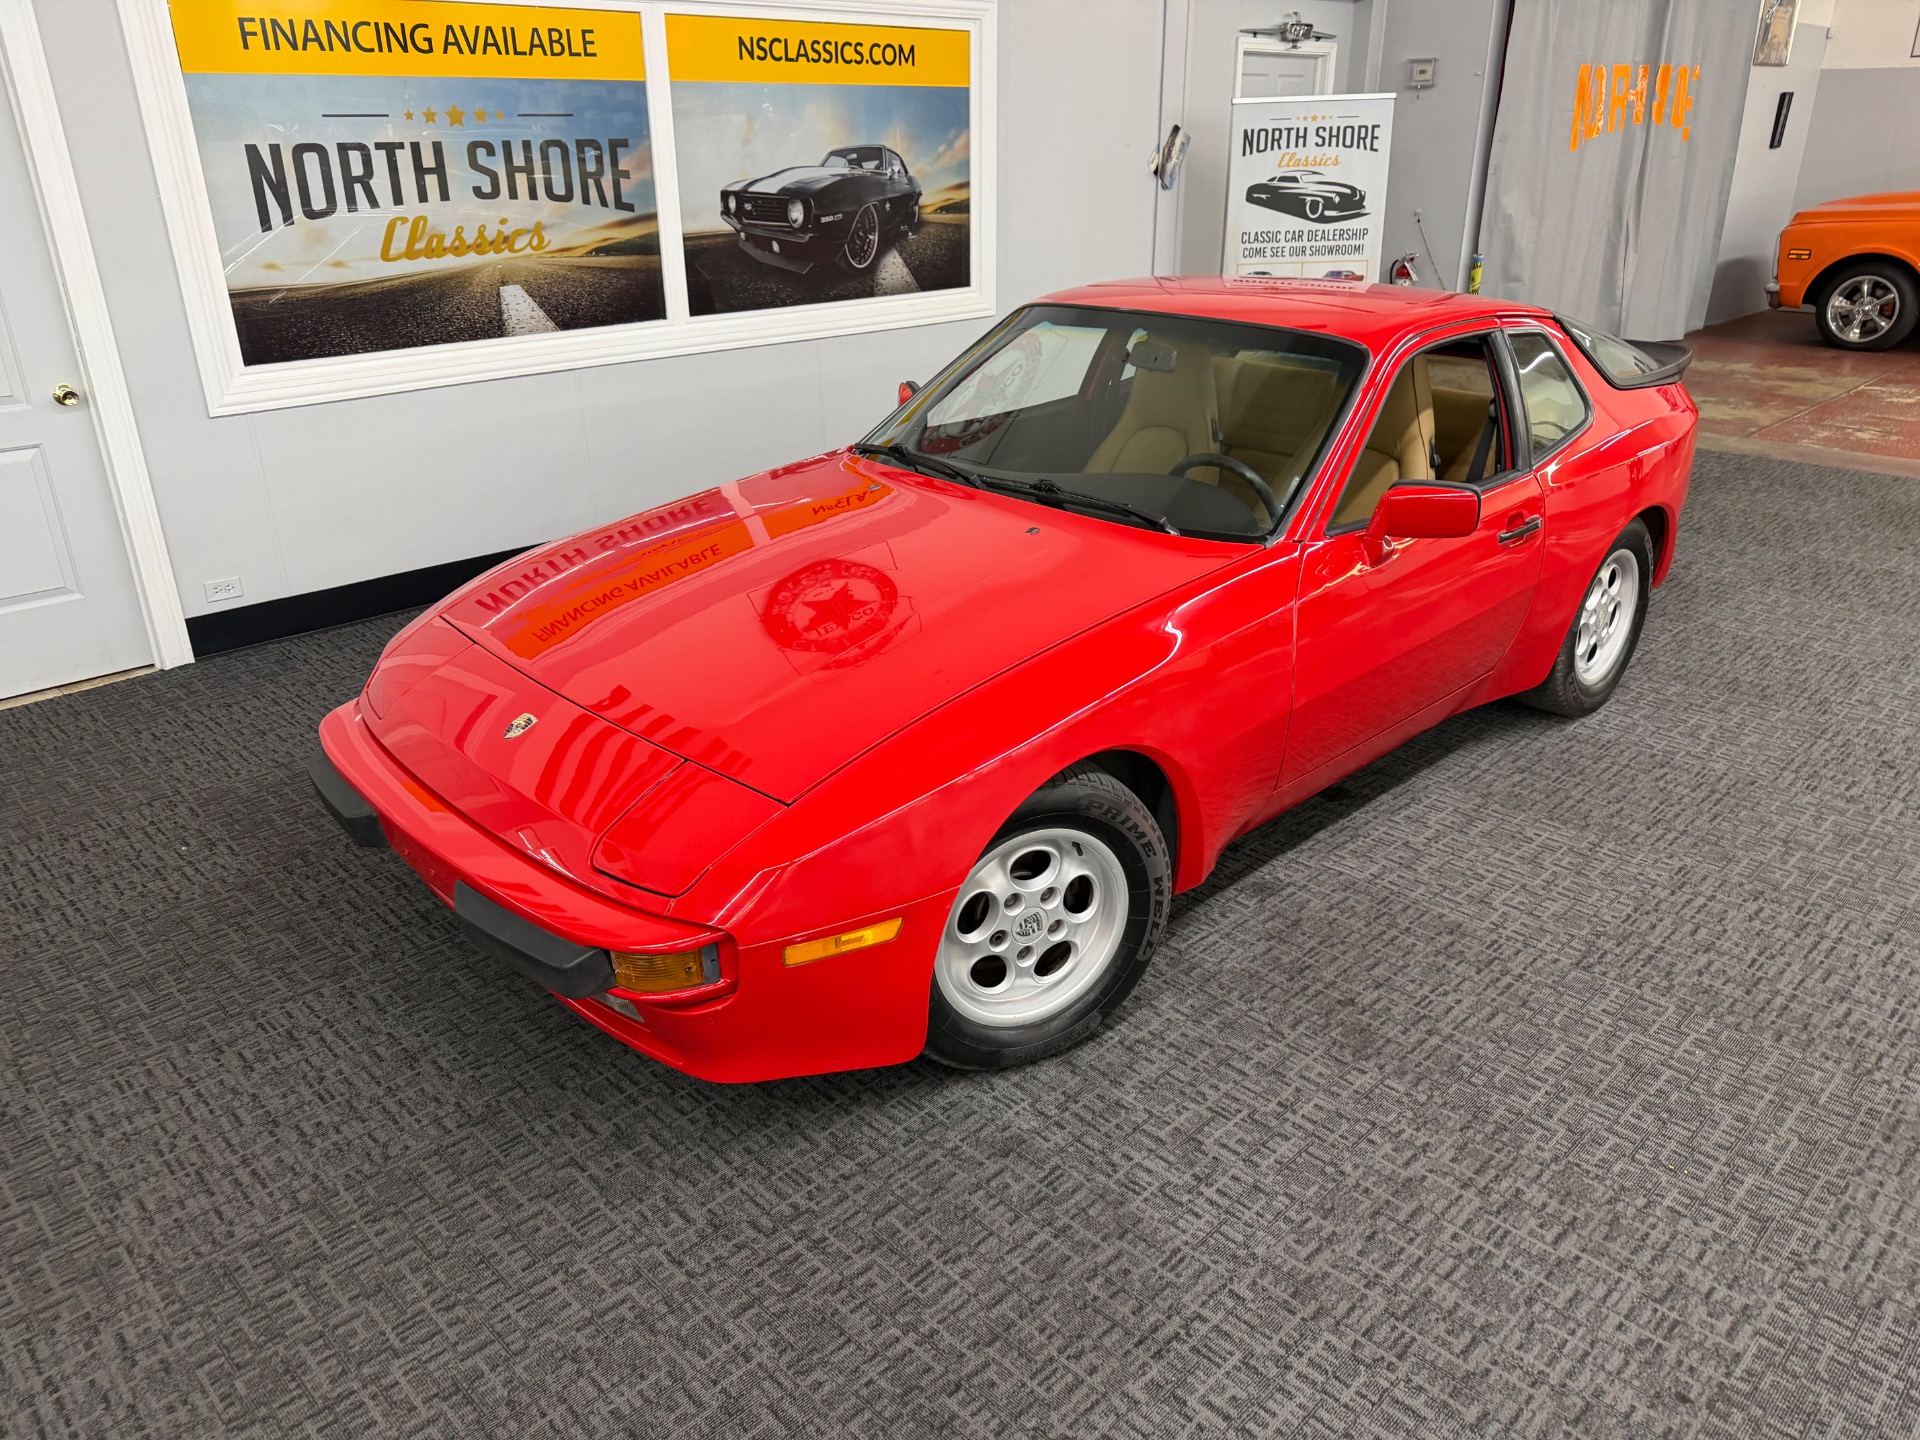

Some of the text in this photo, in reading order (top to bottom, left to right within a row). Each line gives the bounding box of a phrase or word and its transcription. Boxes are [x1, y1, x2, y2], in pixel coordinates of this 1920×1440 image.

[237, 17, 598, 57] FINANCING AVAILABLE
[738, 36, 915, 67] NSCLASSICS.COM
[1243, 124, 1380, 157] NORTH SHORE
[1277, 152, 1341, 168] Classics
[244, 138, 635, 233] NORTH SHORE
[379, 214, 552, 263] Classics
[1241, 228, 1368, 244] CLASSIC CAR DEALERSHIP
[1242, 244, 1364, 259] COME SEE OUR SHOWROOM!
[1083, 801, 1157, 858] PRIME
